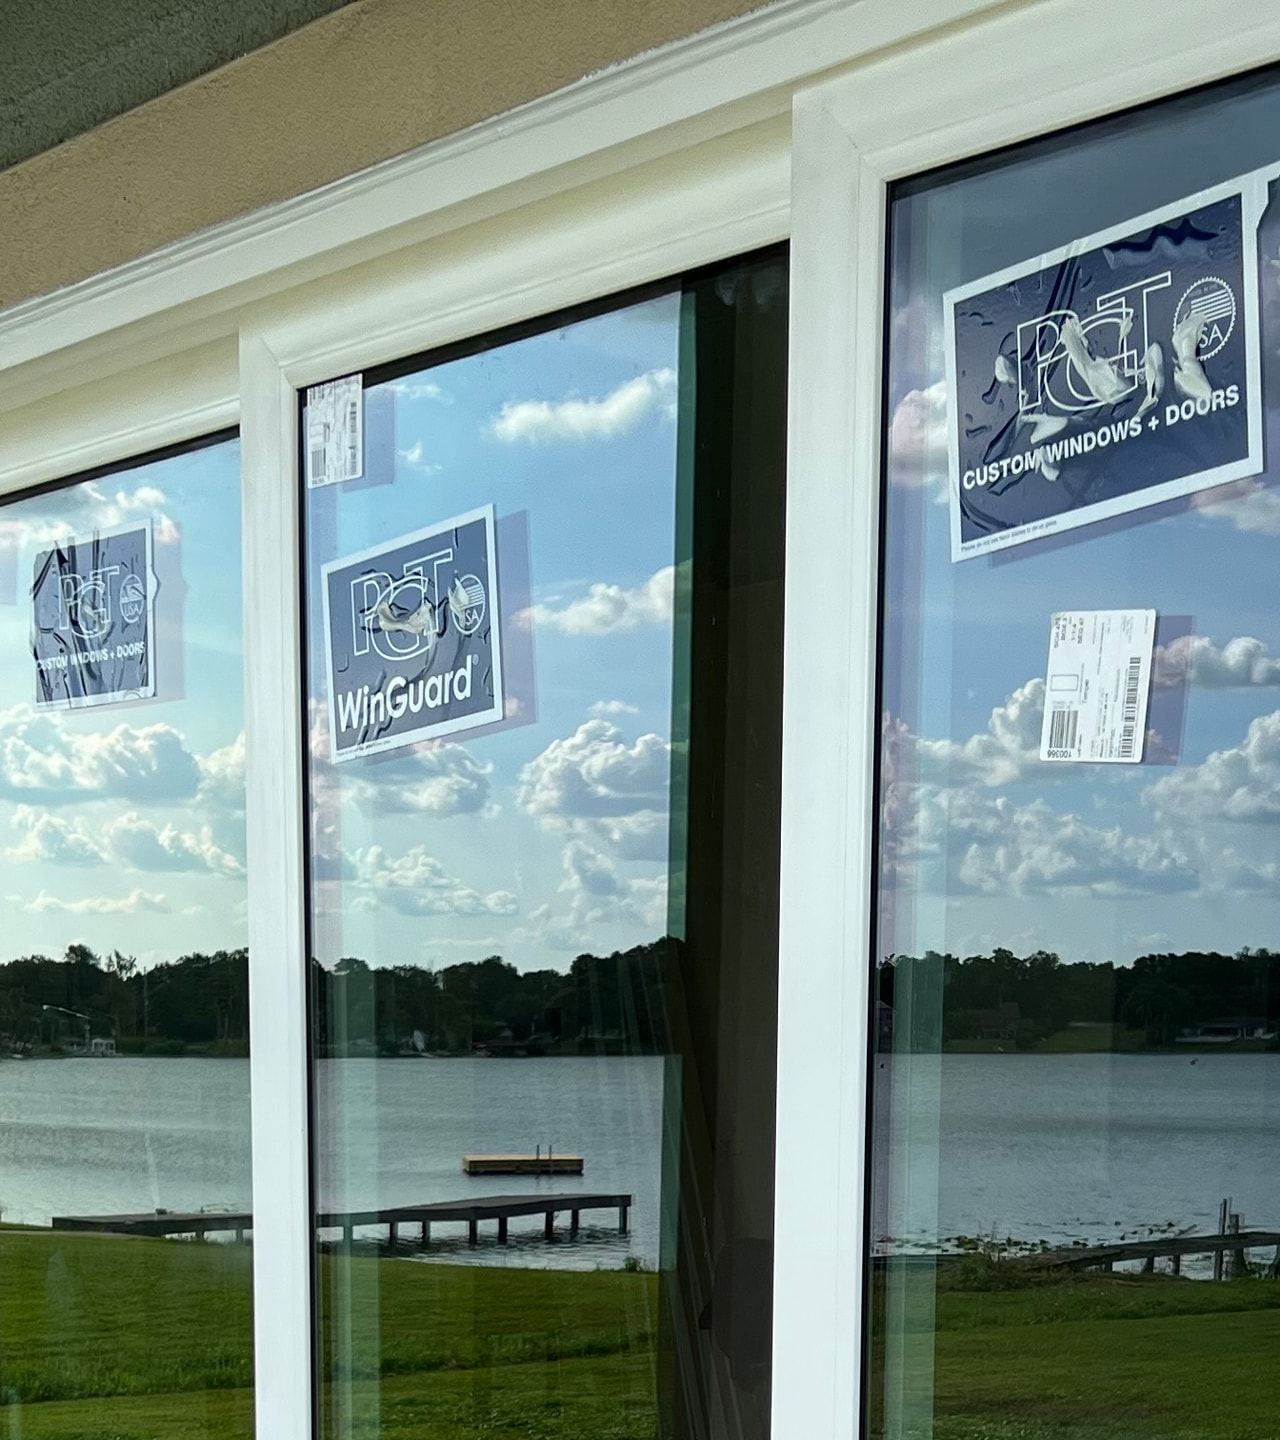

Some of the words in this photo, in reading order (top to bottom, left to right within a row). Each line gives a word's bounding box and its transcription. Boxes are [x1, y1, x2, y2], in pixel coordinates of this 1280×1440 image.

[1016, 270, 1173, 414] PGT
[962, 447, 1042, 490] CUSTOM
[1047, 417, 1143, 464] WINDOWS
[1148, 417, 1160, 431] +
[1165, 384, 1241, 427] DOORS
[58, 565, 120, 639] PGT
[116, 641, 145, 658] DOORS
[351, 548, 453, 661] PGT
